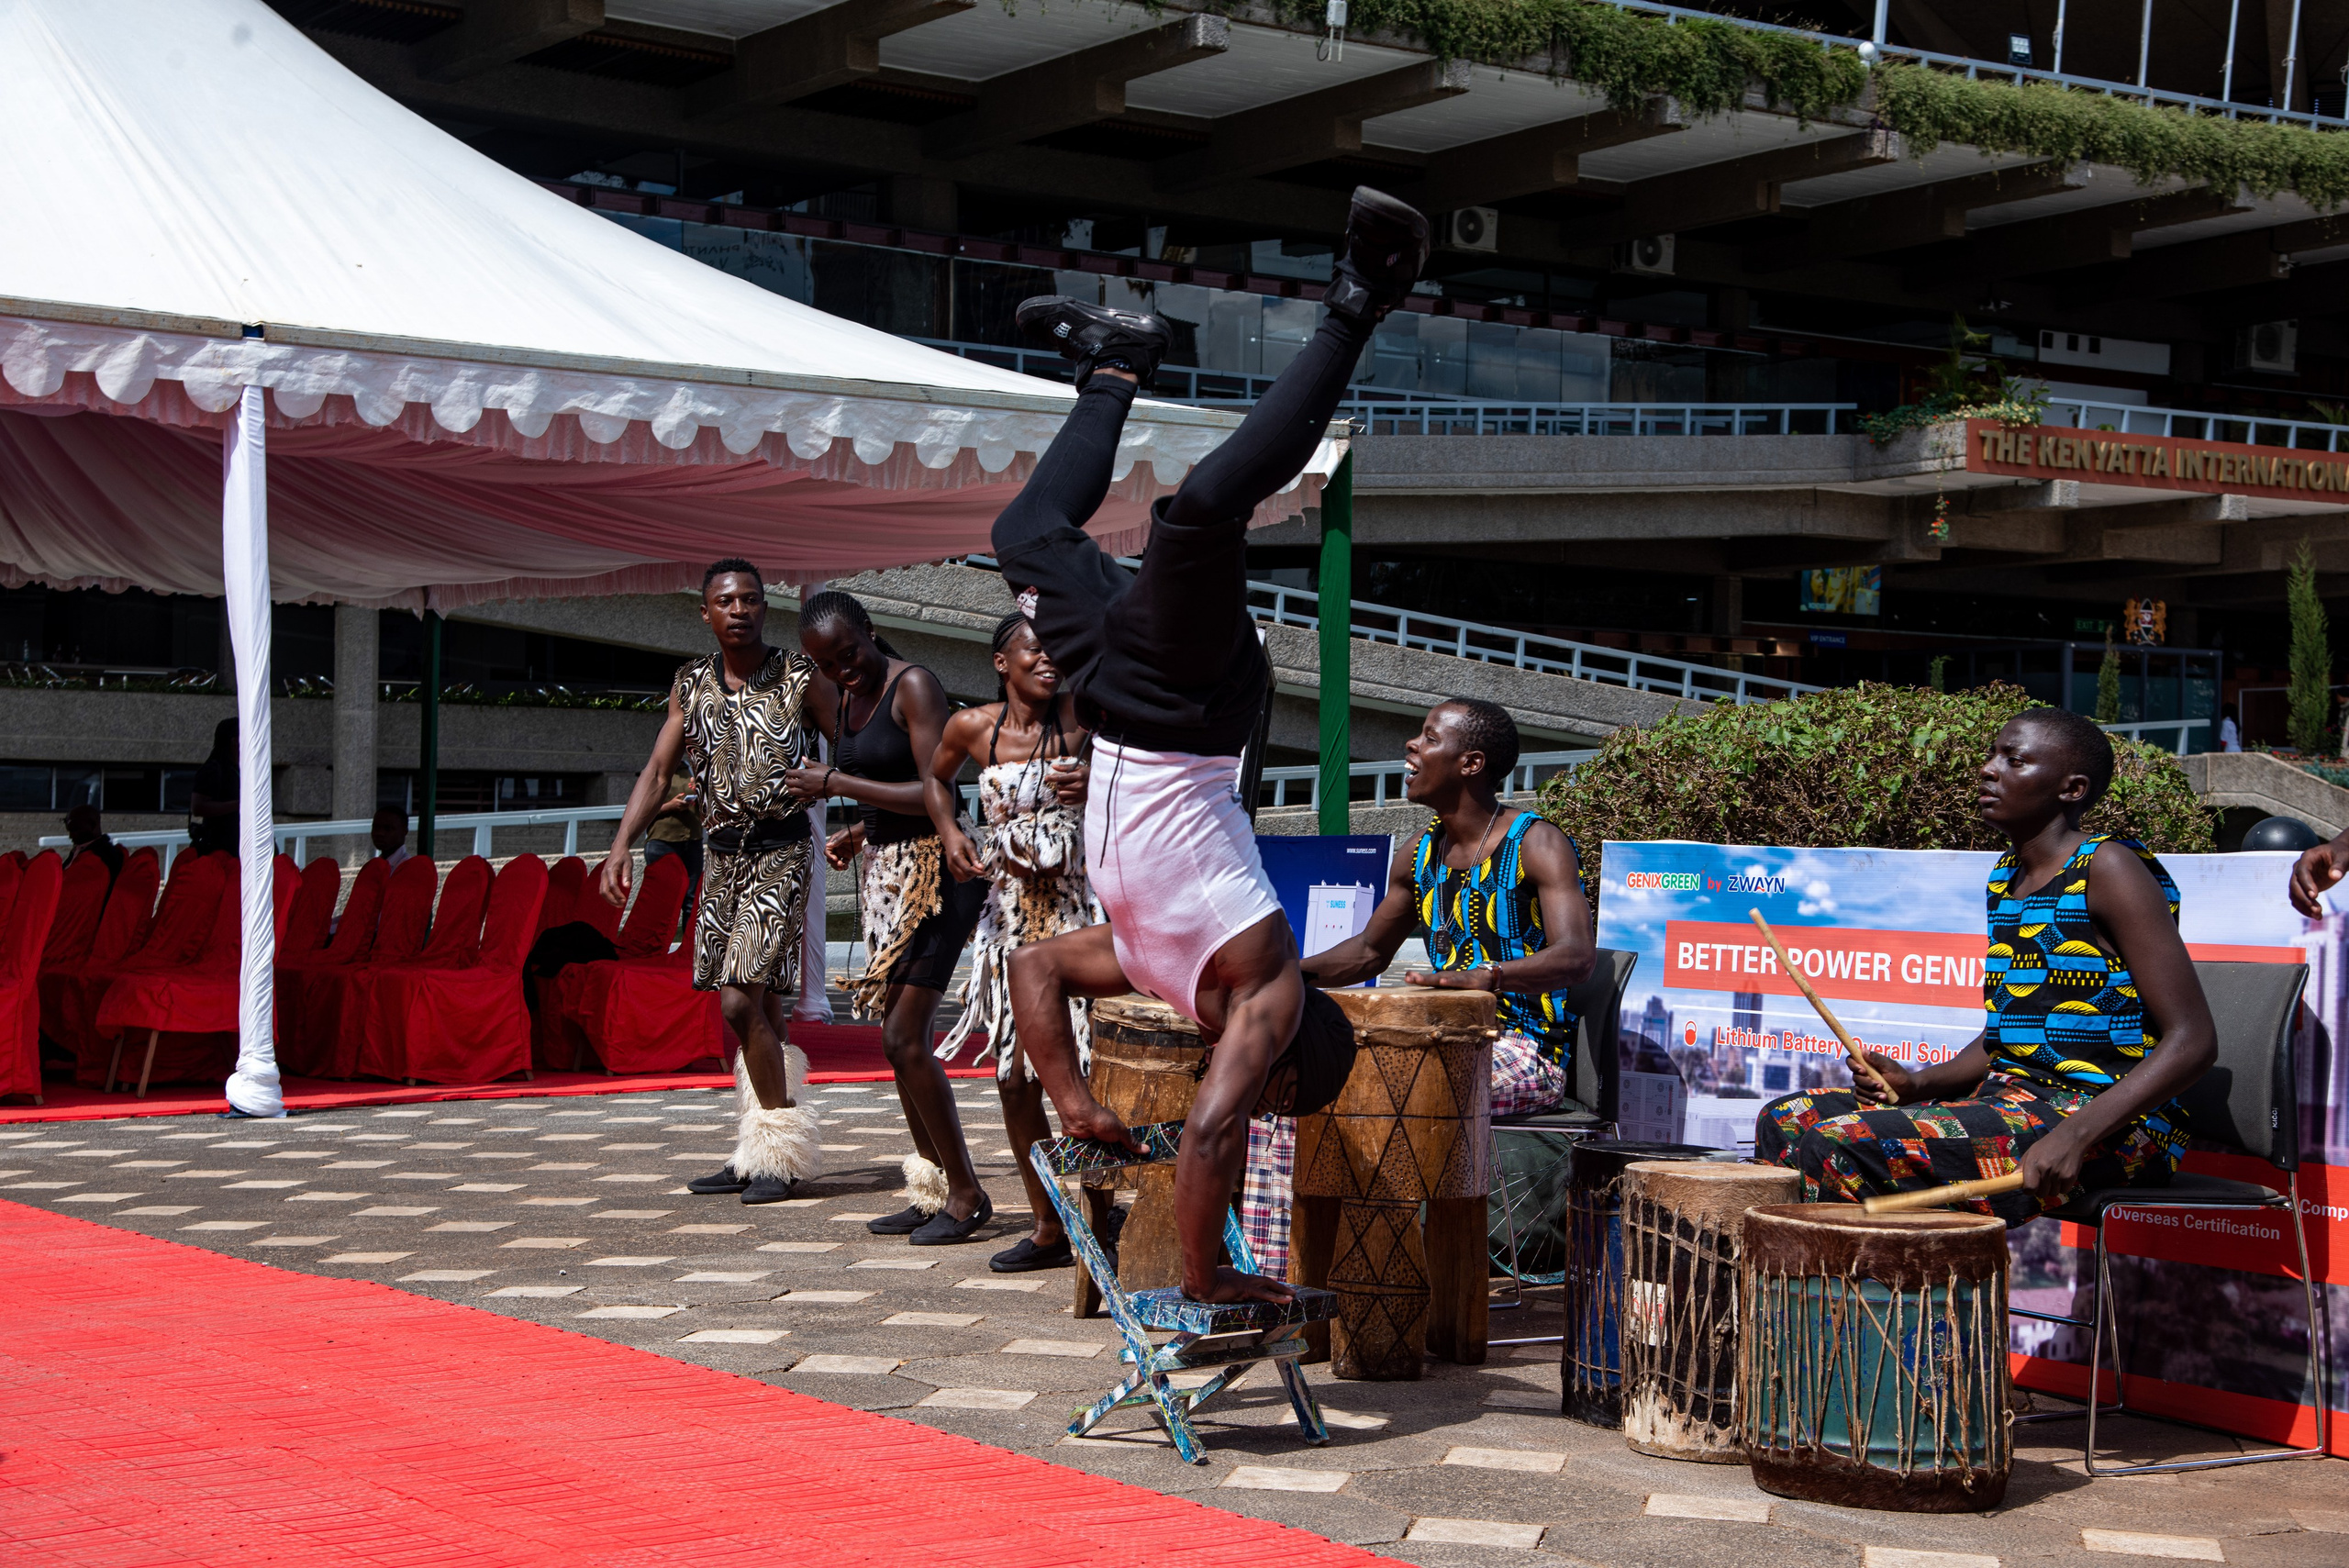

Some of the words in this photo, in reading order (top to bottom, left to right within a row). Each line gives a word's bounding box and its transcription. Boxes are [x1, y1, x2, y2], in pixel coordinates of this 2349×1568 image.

[1978, 429, 2032, 465] THE
[2038, 435, 2171, 478] KENYATTA
[1809, 634, 1819, 642] VIP
[1820, 635, 1846, 644] ENTRANCE
[1627, 873, 1700, 890] GENIXGREEN
[1708, 876, 1722, 893] by
[1728, 874, 1785, 894] ZWAYN
[1330, 900, 1346, 908] SUNESS
[1677, 941, 1777, 974] BETTER
[1787, 948, 1892, 982] POWER
[1717, 1026, 1777, 1050] Lithium
[1783, 1030, 1844, 1060] Battery
[1917, 1041, 1964, 1063] Solu
[2110, 1206, 2179, 1227] Overseas
[2184, 1213, 2280, 1240] Certification
[2299, 1198, 2349, 1221] Comp
